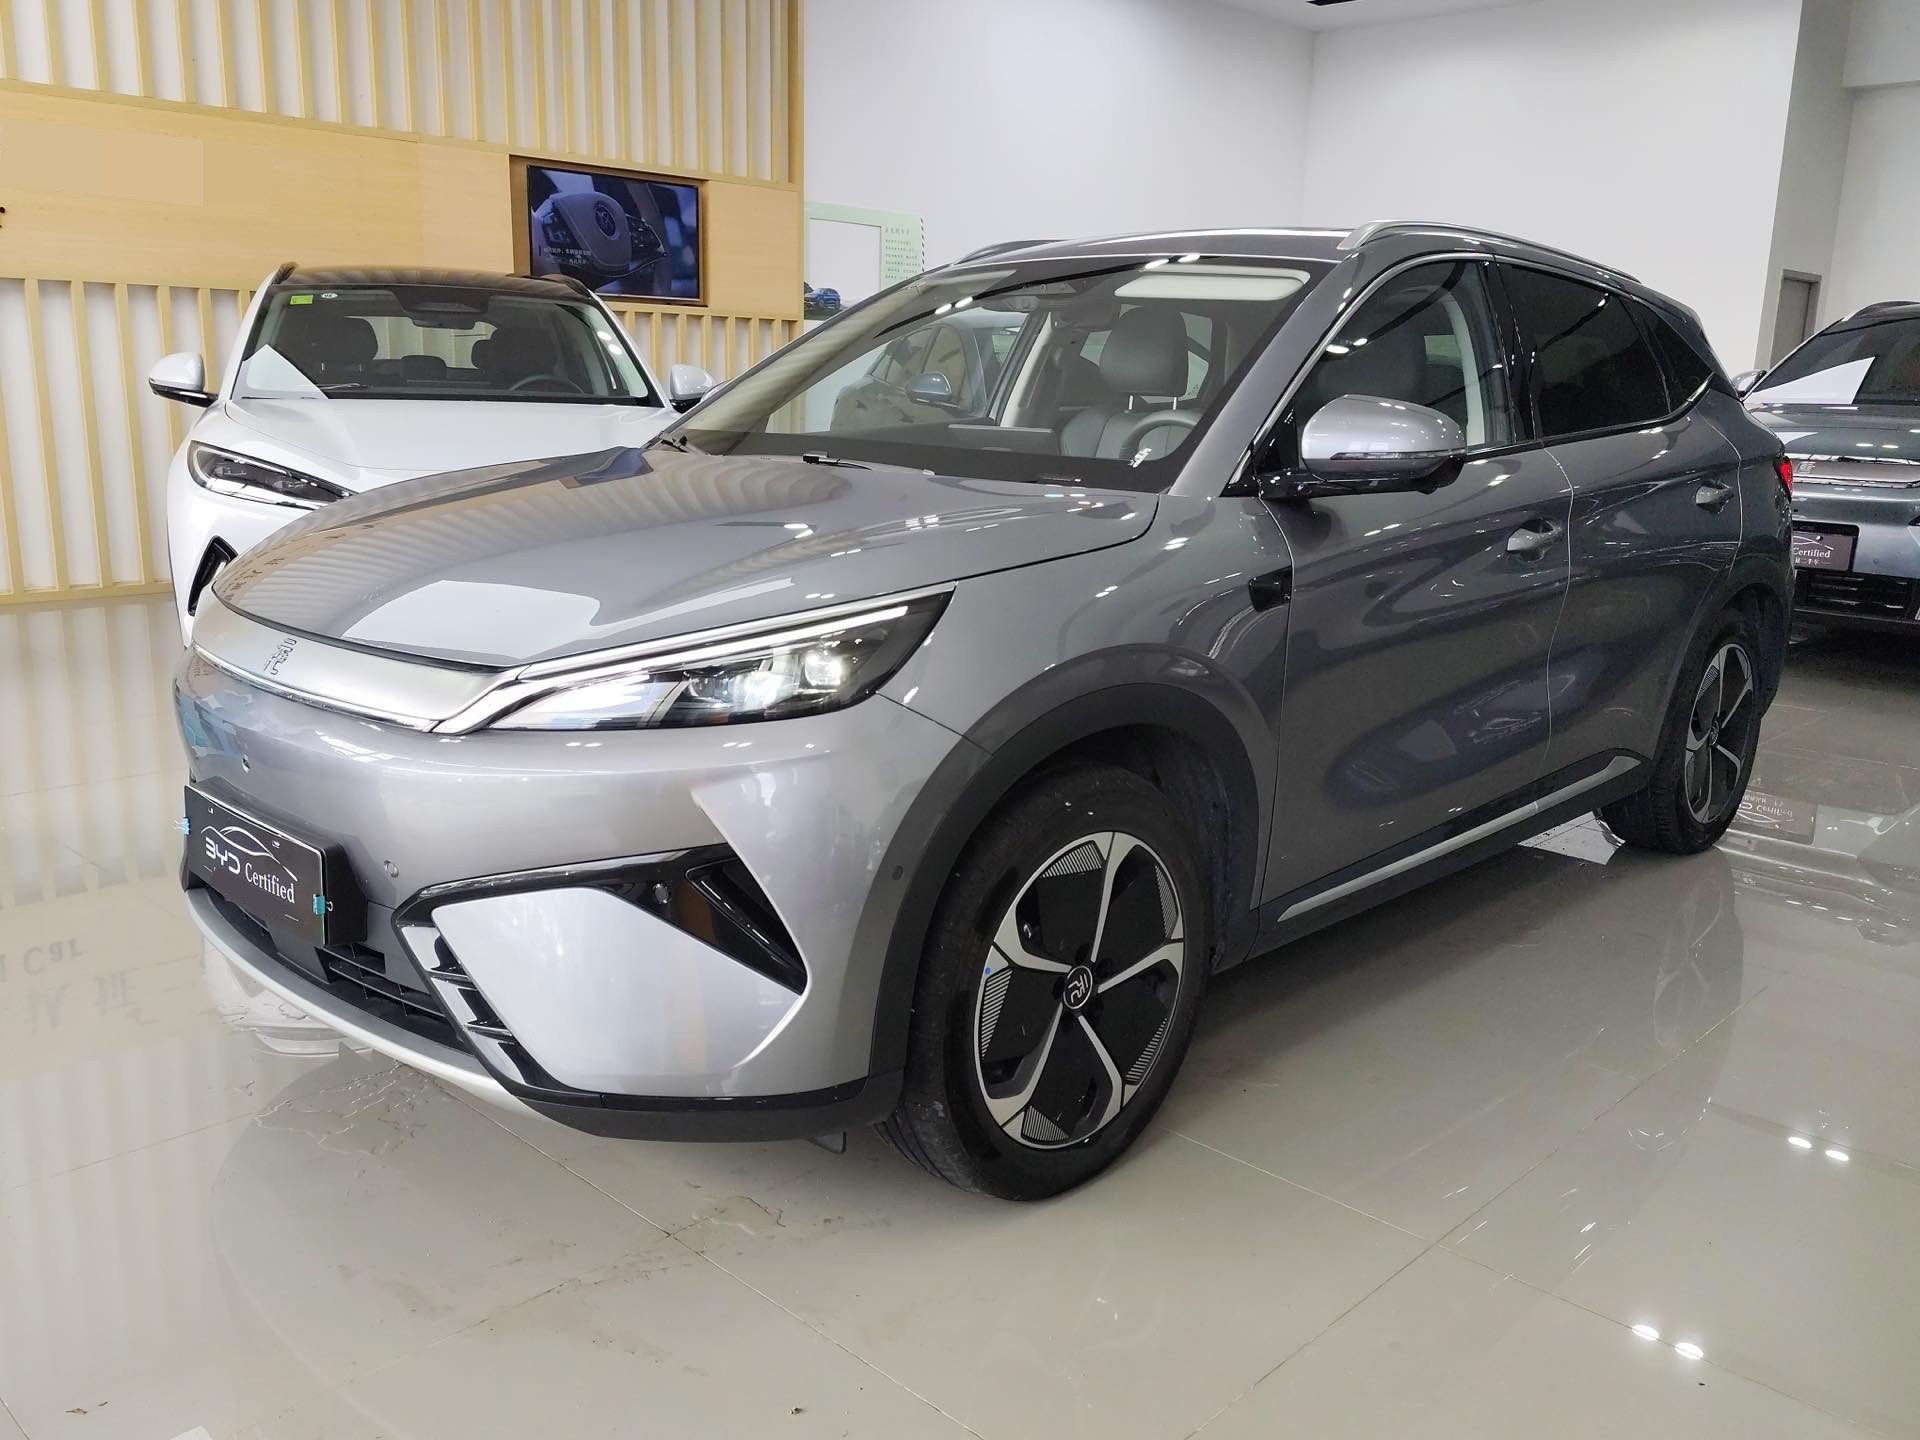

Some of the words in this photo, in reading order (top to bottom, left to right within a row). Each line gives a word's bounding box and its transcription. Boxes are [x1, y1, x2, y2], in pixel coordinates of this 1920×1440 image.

[1793, 547, 1831, 559] Certified
[205, 836, 241, 875] BYD
[245, 862, 295, 904] Certified
